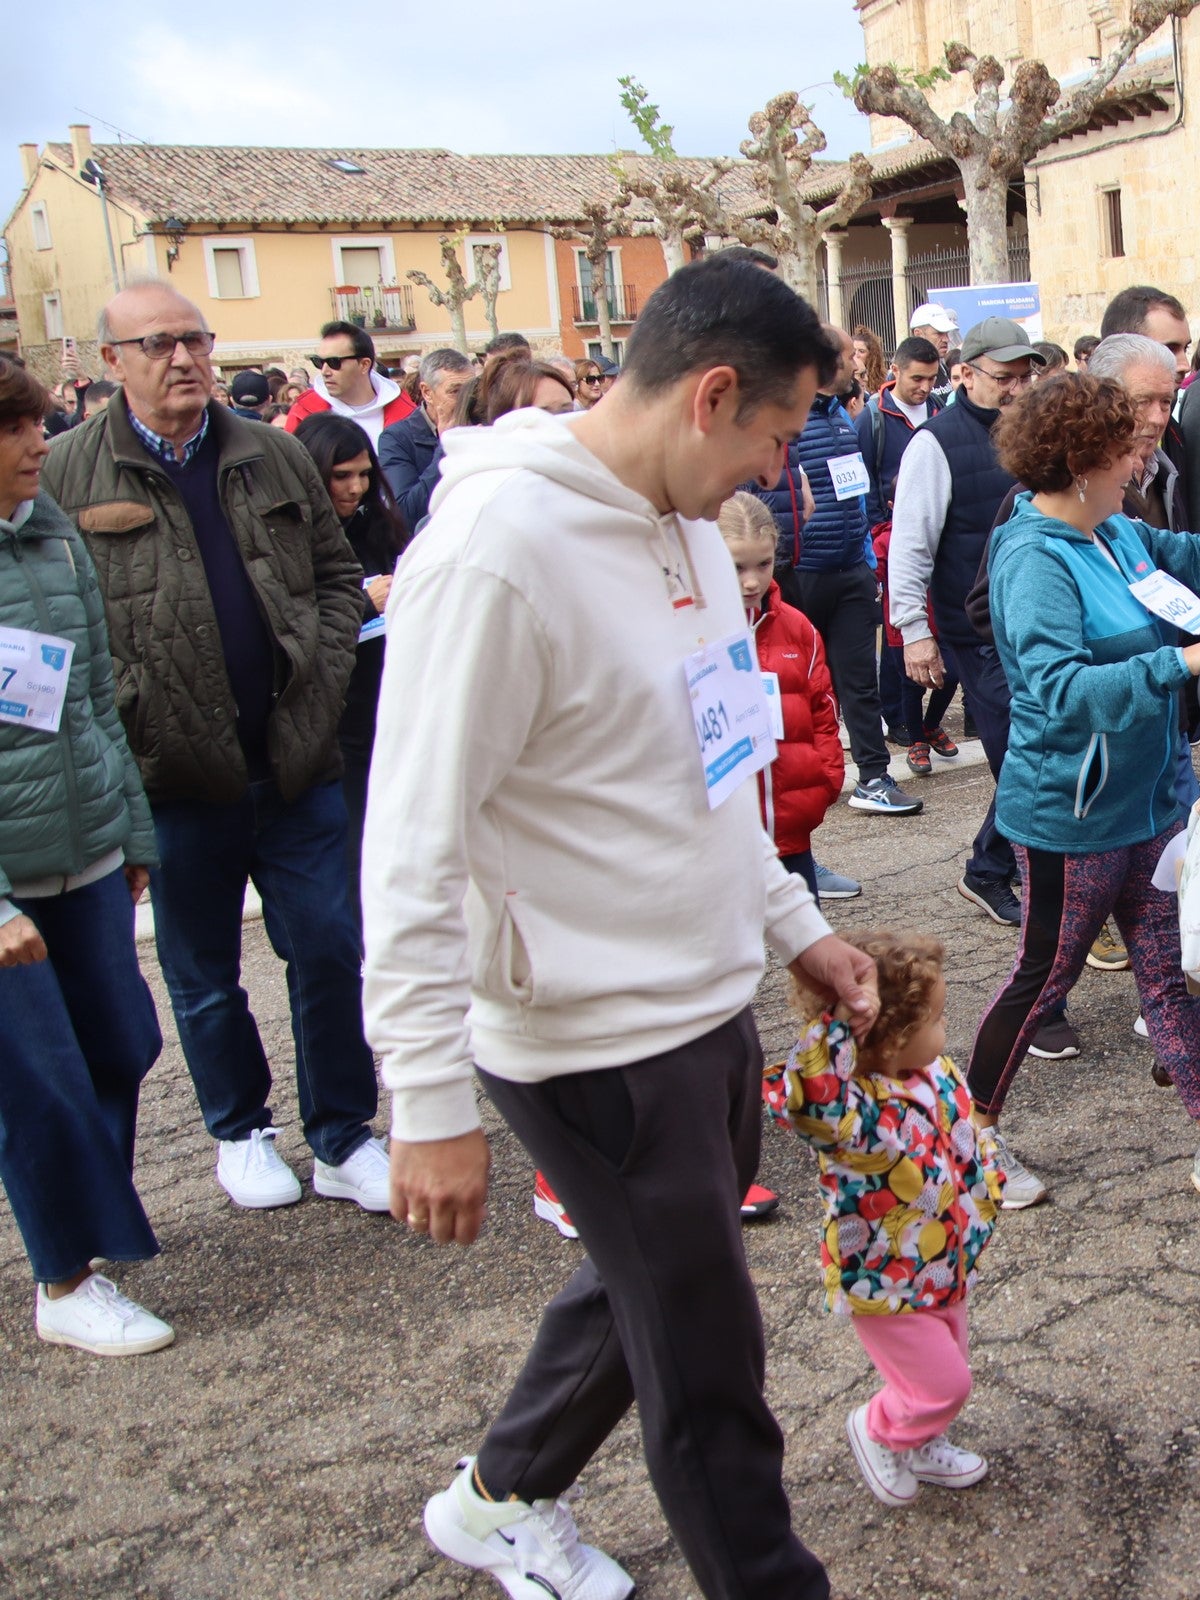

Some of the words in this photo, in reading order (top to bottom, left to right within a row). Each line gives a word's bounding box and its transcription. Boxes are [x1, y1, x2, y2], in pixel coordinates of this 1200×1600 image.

[981, 298, 1005, 306] MARCHA
[1006, 296, 1035, 304] SOLIDARIA
[836, 469, 857, 485] 0331
[1158, 597, 1193, 621] 0482
